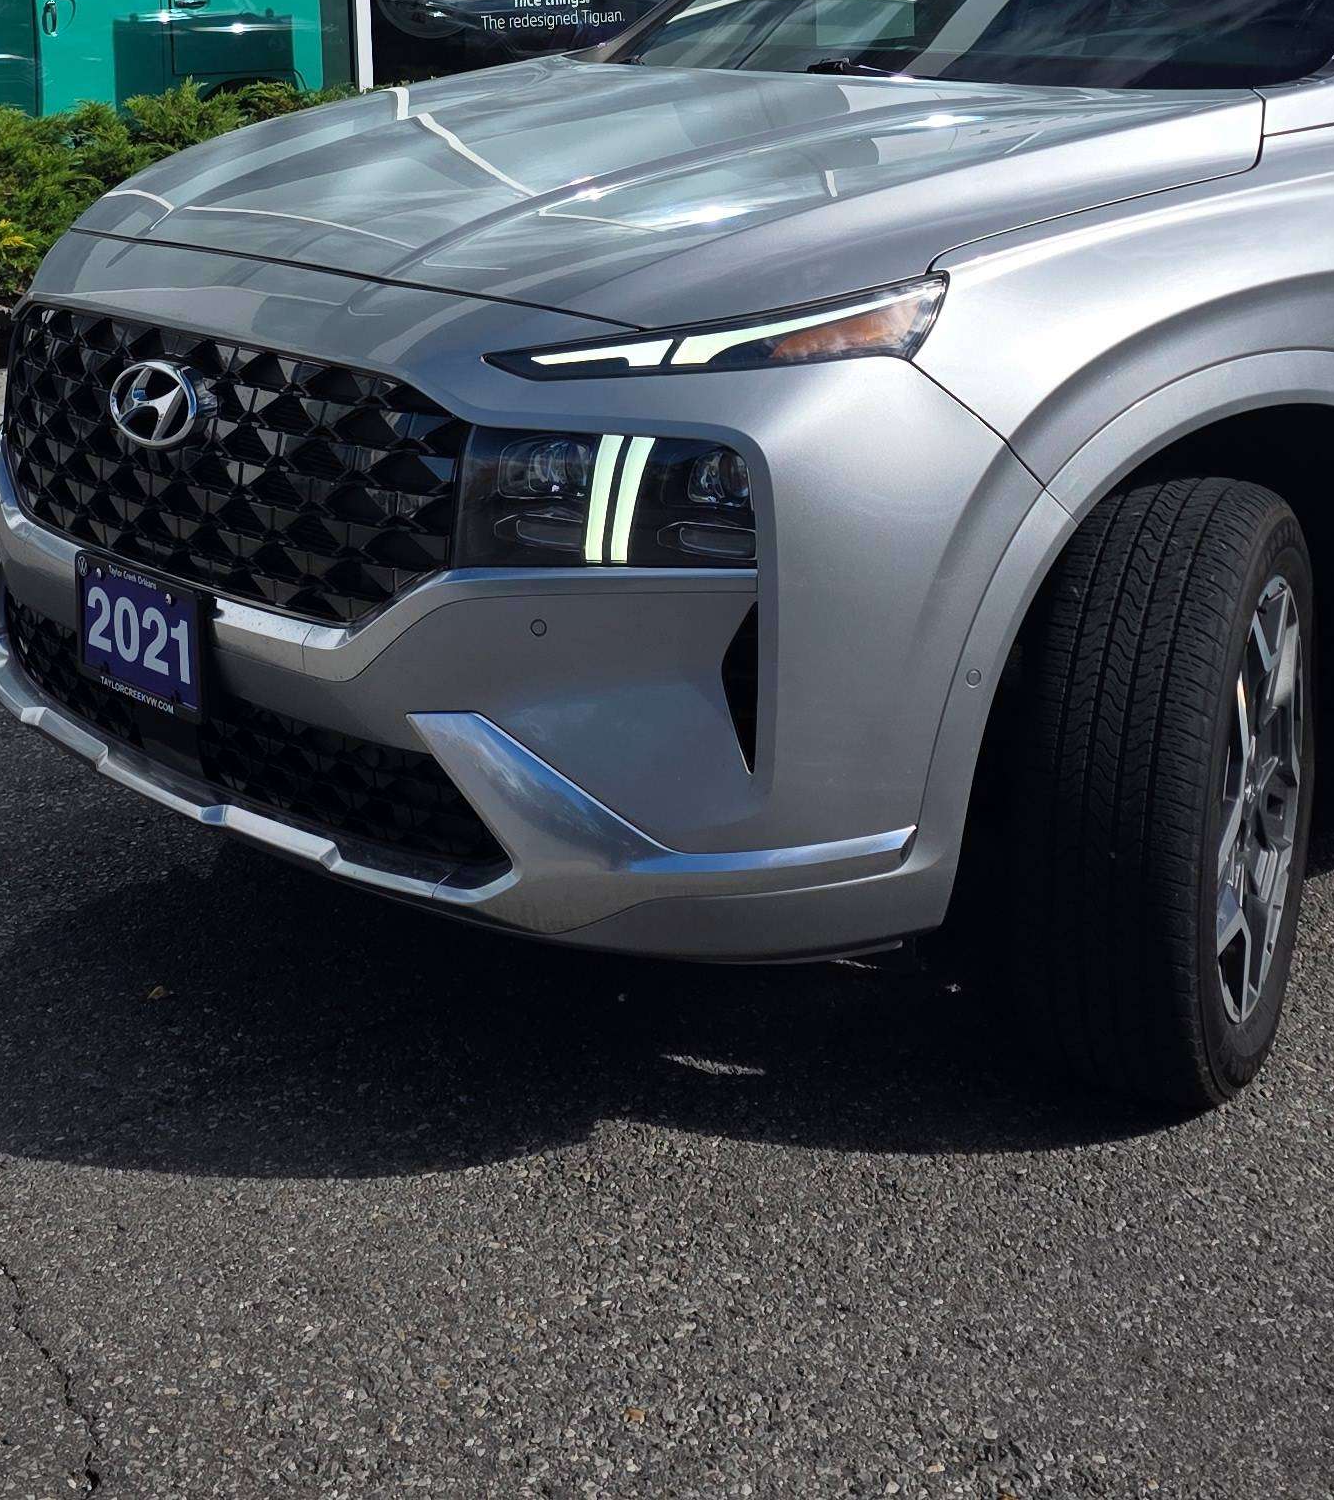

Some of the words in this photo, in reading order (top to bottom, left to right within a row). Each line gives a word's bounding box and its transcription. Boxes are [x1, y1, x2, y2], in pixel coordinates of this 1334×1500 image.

[481, 15, 506, 30] The
[509, 10, 578, 30] redesigned
[581, 9, 626, 27] Tiguan.
[108, 564, 123, 578] Taylor
[123, 570, 137, 582] Creek
[87, 586, 191, 685] 2021
[99, 675, 174, 714] TAYLORCREEKVW.COM
